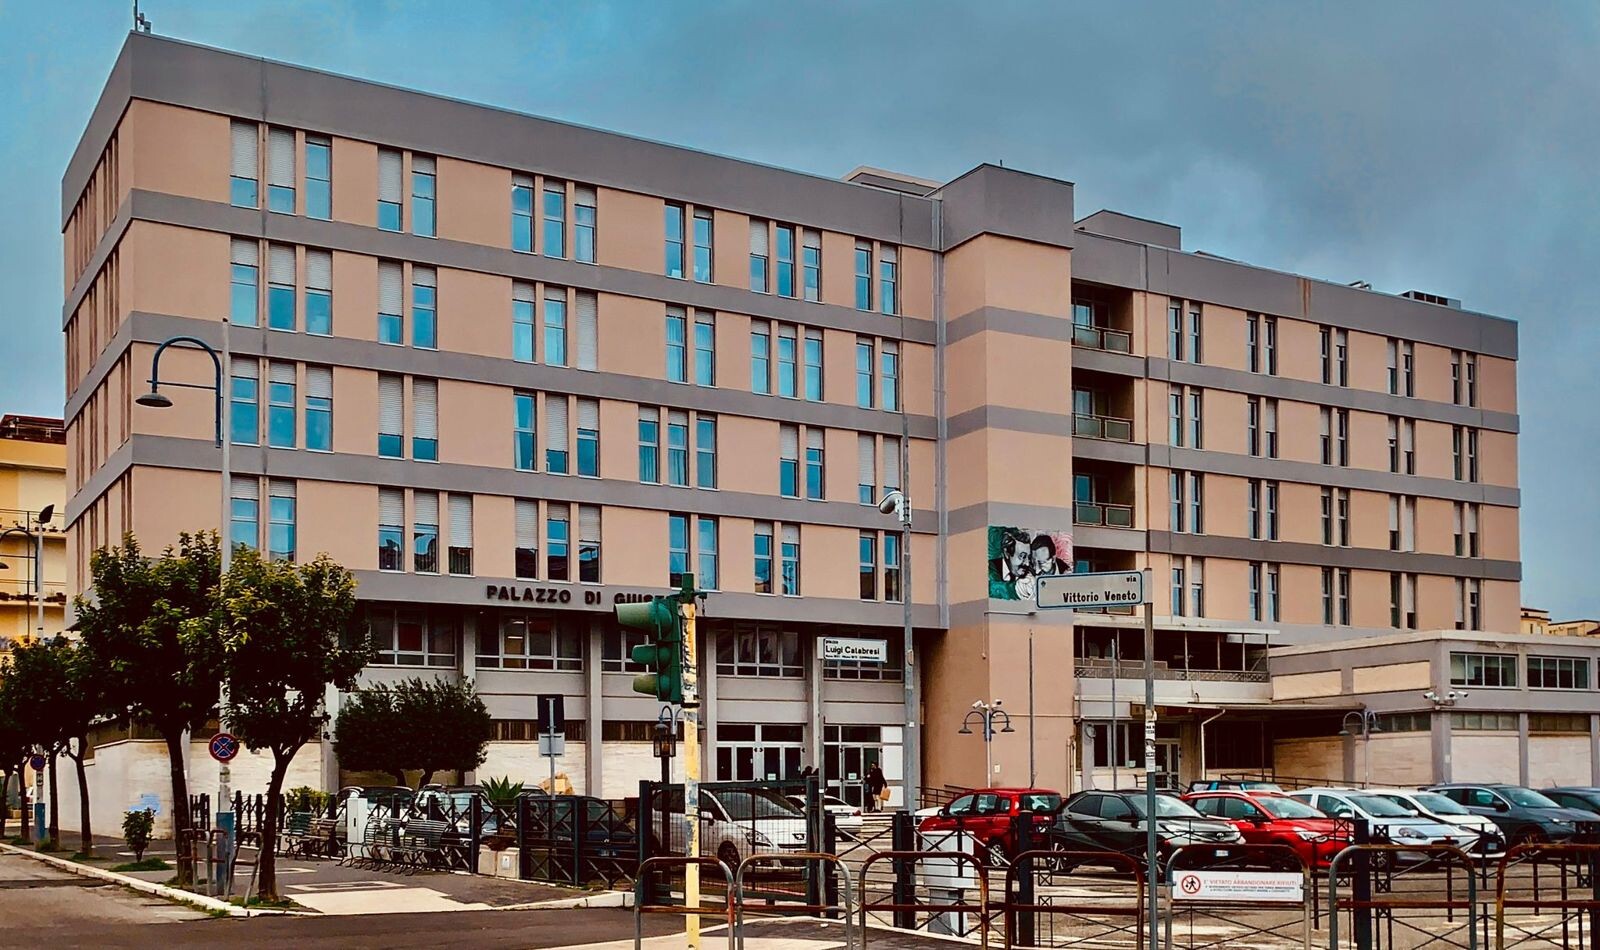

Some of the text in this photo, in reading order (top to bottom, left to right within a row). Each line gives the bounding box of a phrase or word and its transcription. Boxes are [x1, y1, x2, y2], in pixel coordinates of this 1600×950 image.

[486, 585, 571, 604] PALAZZO
[584, 591, 601, 605] DI
[1063, 590, 1137, 603] Vittorio Veneto
[825, 645, 880, 655] Luigi Calabresi
